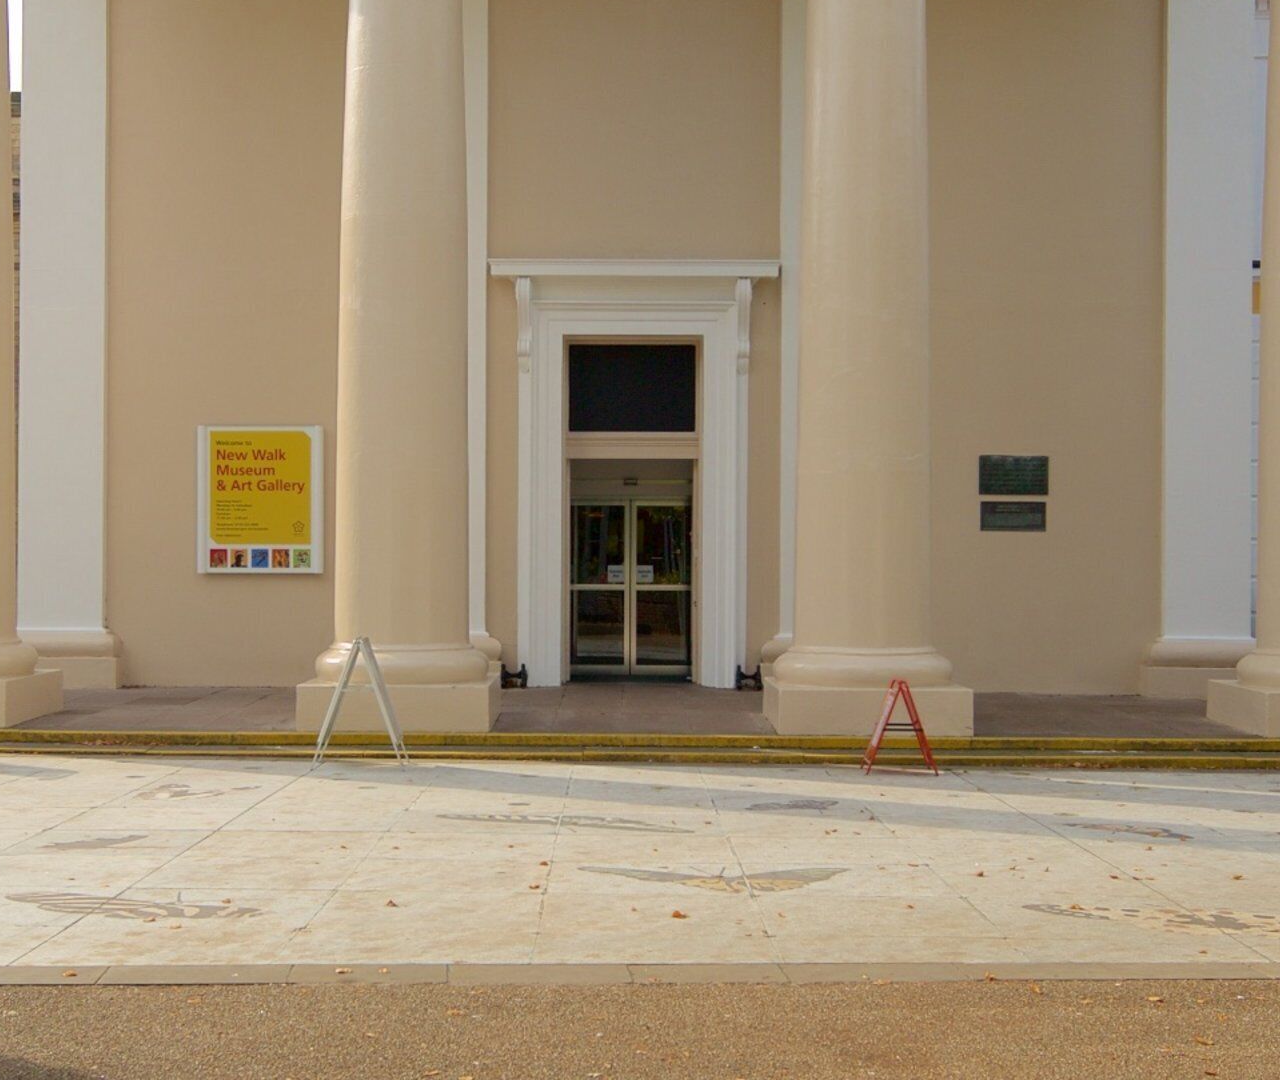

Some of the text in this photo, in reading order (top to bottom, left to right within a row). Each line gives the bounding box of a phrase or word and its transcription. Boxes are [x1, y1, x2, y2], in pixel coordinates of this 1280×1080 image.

[216, 448, 287, 461] New Walk
[216, 464, 276, 476] Museum
[216, 479, 306, 495] & Art Gallery
